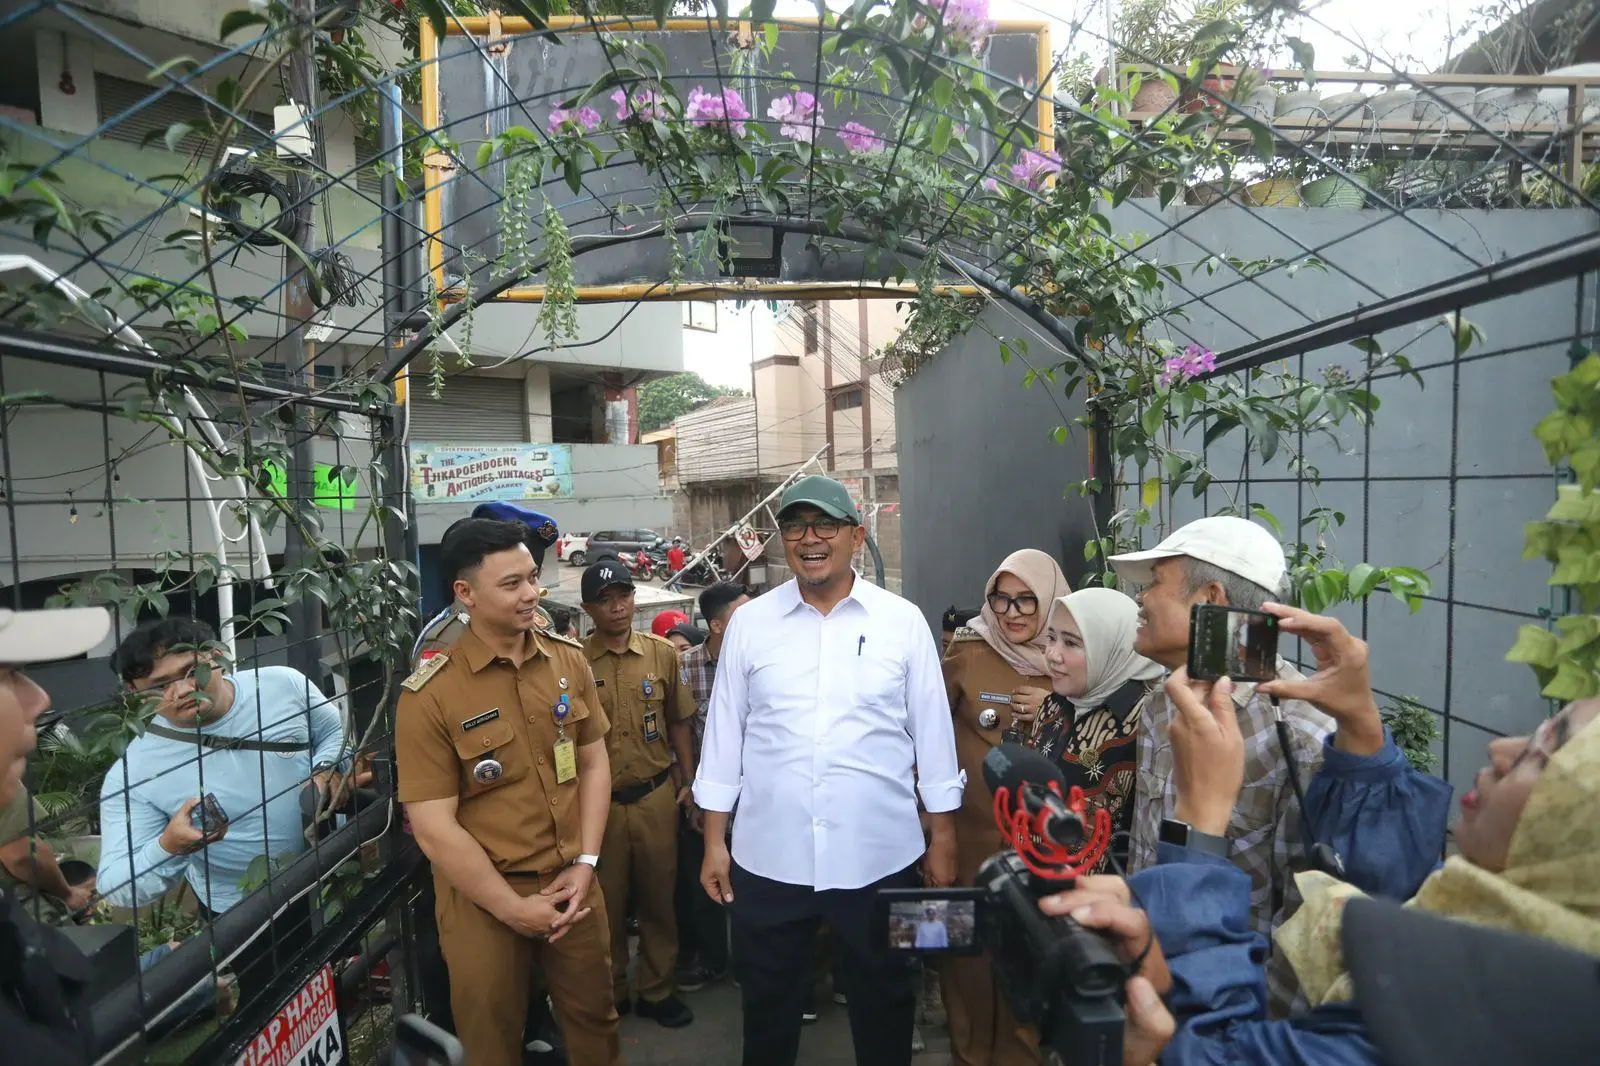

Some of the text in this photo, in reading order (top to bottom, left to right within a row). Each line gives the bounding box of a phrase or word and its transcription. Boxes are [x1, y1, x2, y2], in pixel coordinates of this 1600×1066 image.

[420, 456, 517, 485] TJIKAPOENDOENG
[440, 458, 455, 467] THE
[286, 969, 329, 1029] HARI
